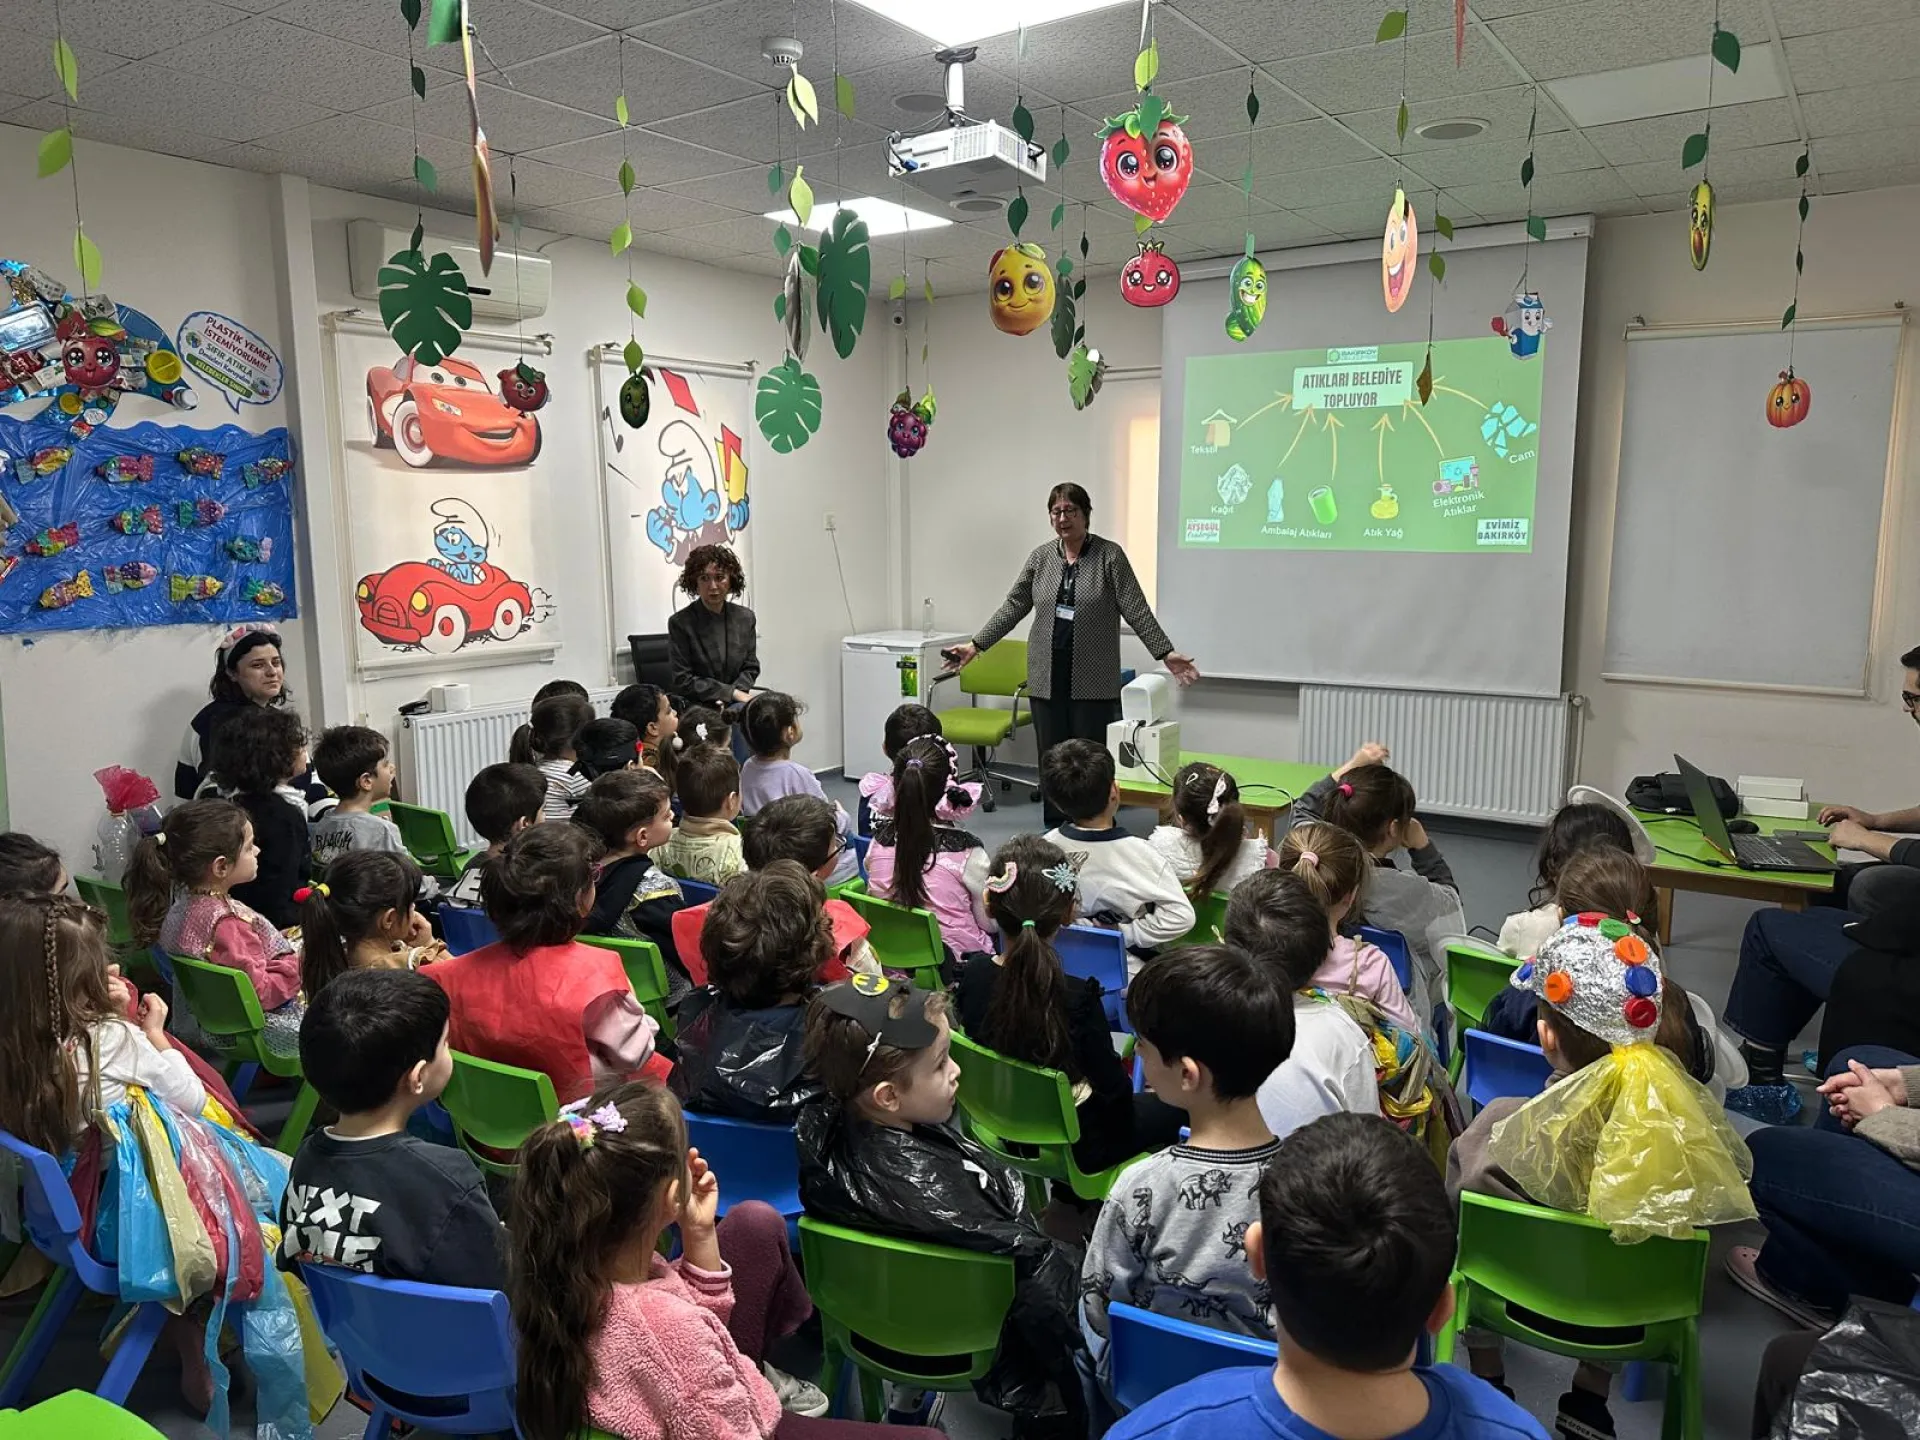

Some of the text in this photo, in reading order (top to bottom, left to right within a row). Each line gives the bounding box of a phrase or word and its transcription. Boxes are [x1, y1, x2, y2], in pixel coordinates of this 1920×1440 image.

[206, 316, 273, 363] PLASTİK YEMEK
[204, 326, 267, 372] İSTEMİYORUM!!!
[206, 342, 253, 377] SIFIR ATIKLA
[1302, 367, 1402, 389] ATIKLARI BELEDİYE
[1323, 391, 1378, 408] TOPLUYOR
[1190, 445, 1218, 454] Tekstil
[1508, 450, 1535, 464] Cam
[1432, 491, 1485, 508] Elektronik
[1443, 503, 1477, 518] Atıklar
[1260, 525, 1332, 539] Ambalaj Atıkları
[1485, 519, 1520, 529] EVİMİZ
[1363, 527, 1404, 539] Atık Yağ
[1477, 529, 1527, 540] BAKIRKÖY
[286, 1177, 381, 1234] NEXT
